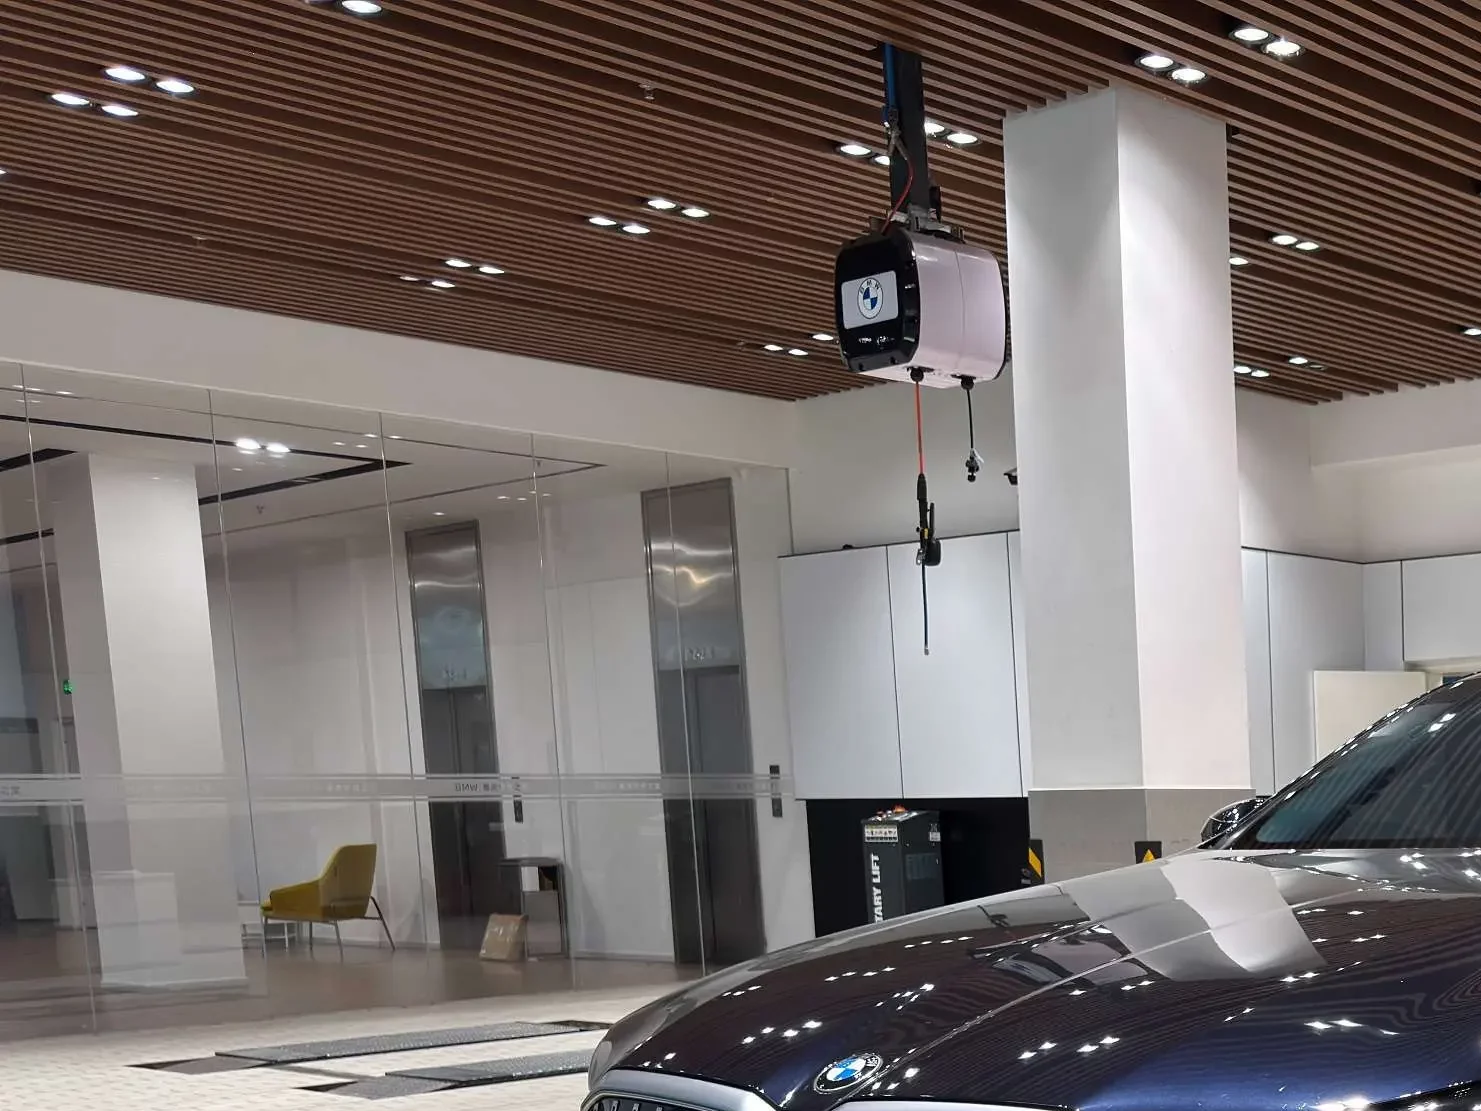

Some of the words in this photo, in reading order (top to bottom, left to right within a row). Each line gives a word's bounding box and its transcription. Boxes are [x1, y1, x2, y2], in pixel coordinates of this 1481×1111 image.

[859, 279, 882, 294] BMW
[871, 852, 881, 884] LIFT
[873, 887, 884, 923] TARY
